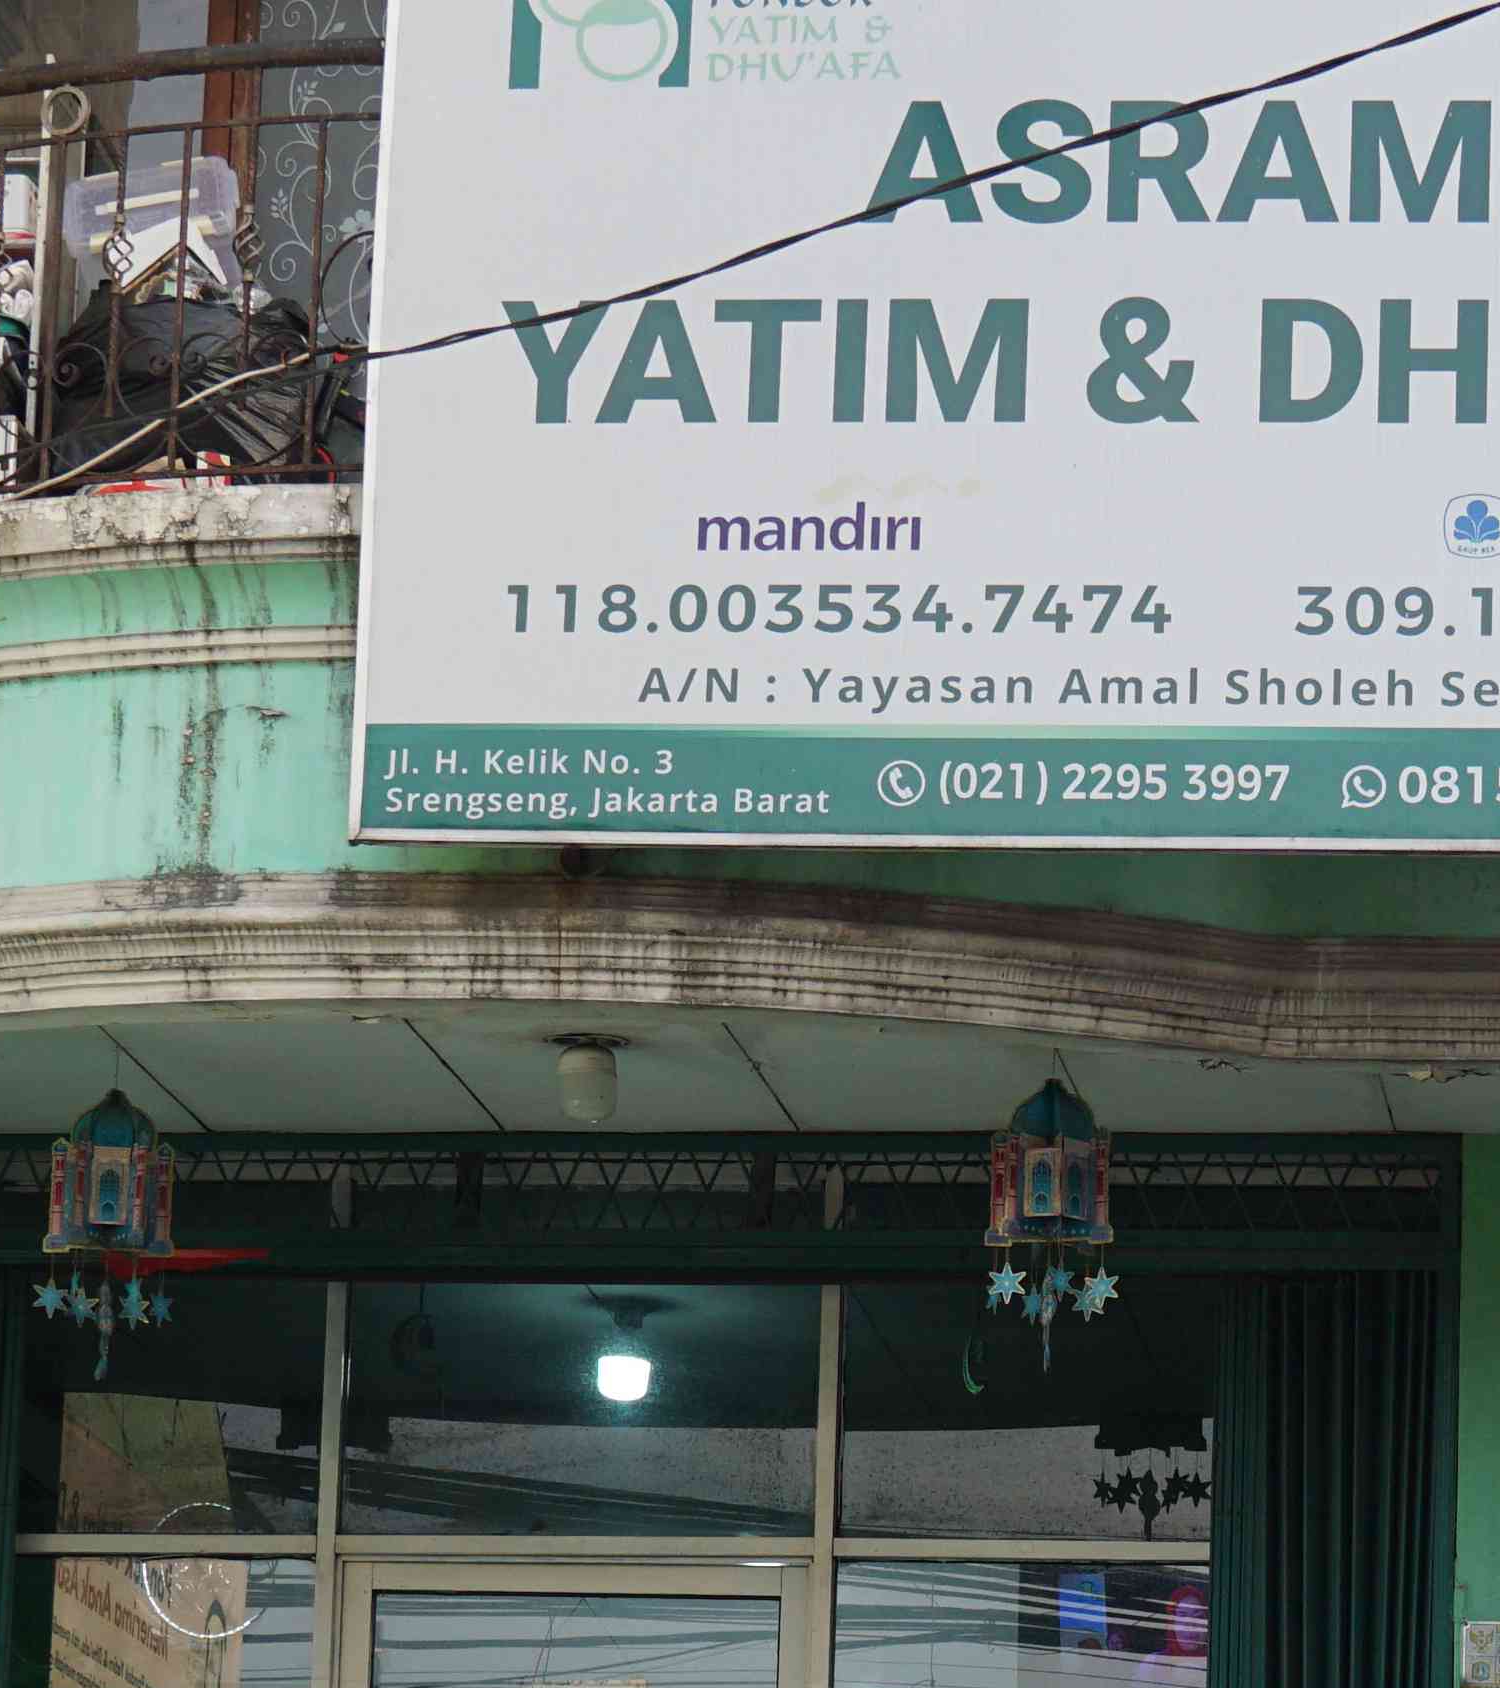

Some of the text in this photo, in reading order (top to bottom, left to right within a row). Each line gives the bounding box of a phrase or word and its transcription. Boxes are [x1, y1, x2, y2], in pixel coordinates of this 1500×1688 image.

[708, 16, 839, 44] YATIM
[502, 297, 1029, 425] YATIM
[1086, 296, 1199, 425] &
[507, 581, 1172, 637] 118.003534.7474
[638, 666, 741, 706] A/N
[802, 666, 1034, 715] Yayasan
[1058, 666, 1200, 707] Amal
[1225, 667, 1414, 708] Sholeh
[384, 749, 674, 781] Jl. H. Kelik No. 3
[940, 761, 1290, 808] (021) 2295 3997
[385, 786, 829, 820] Srengseng, Jakarta Barat
